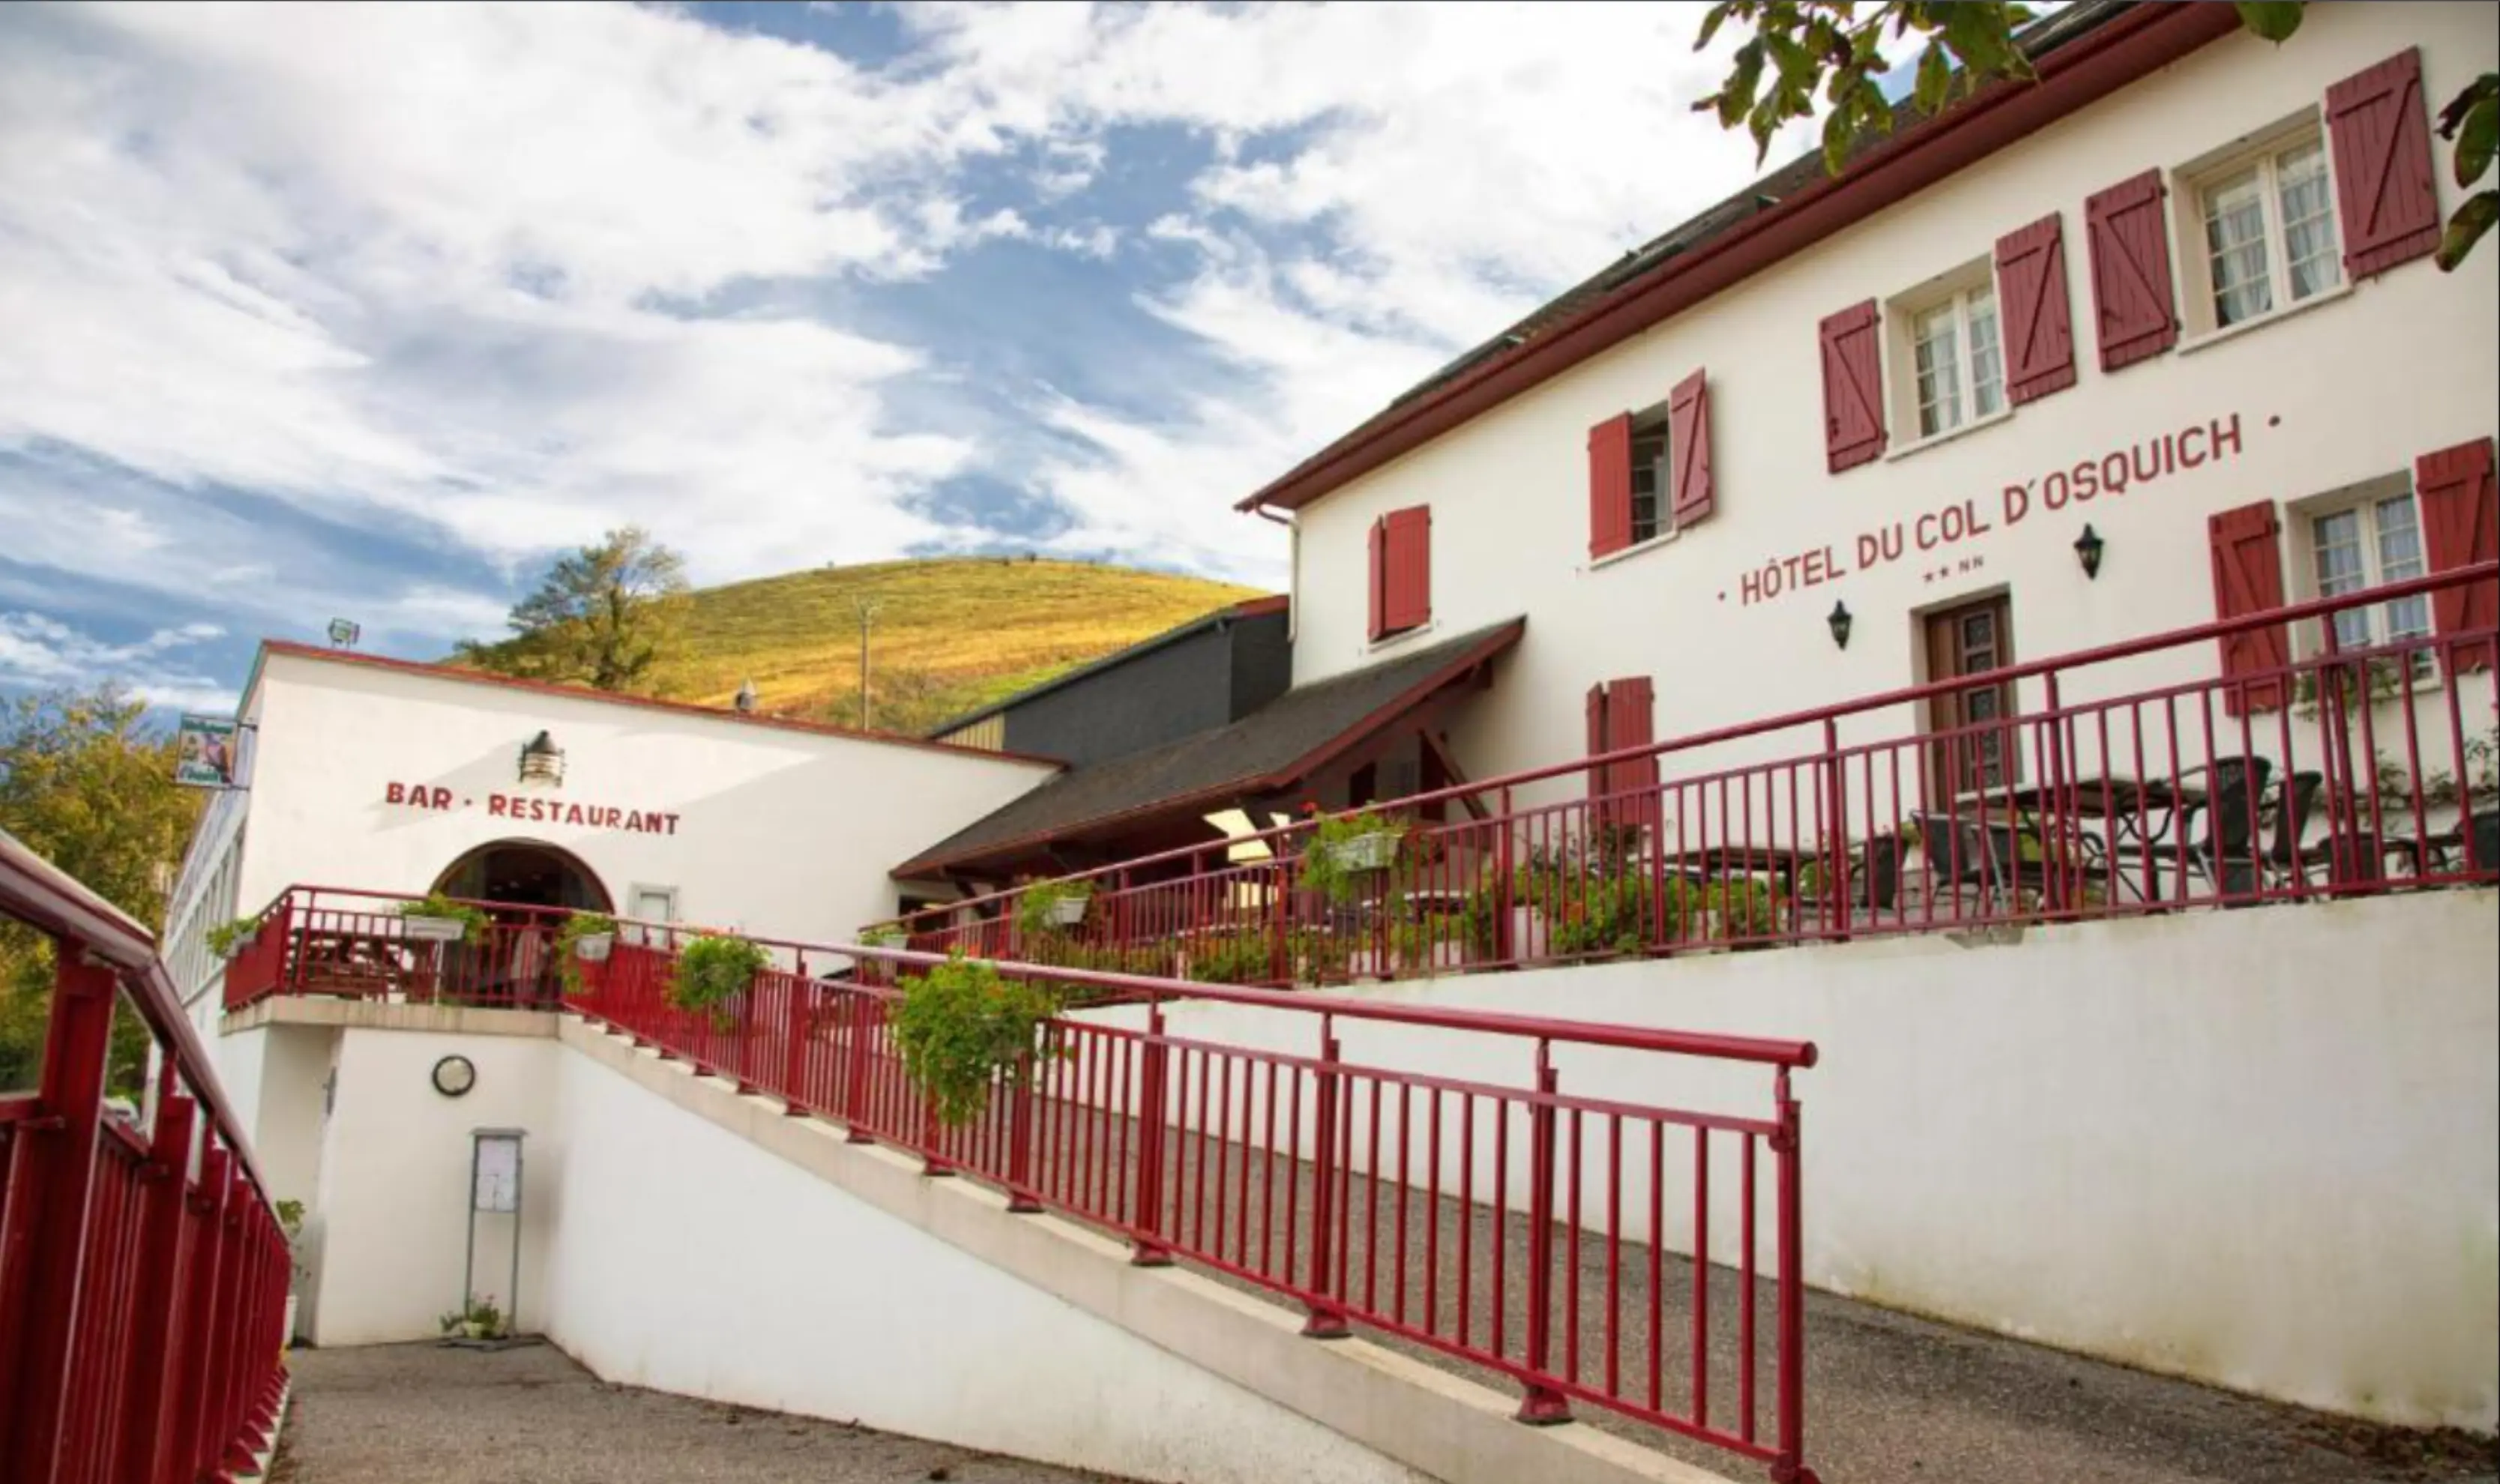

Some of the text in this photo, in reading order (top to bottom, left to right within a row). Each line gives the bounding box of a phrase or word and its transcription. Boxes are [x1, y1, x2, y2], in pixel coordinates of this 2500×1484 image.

[1741, 545, 1847, 606] HÔTEL
[1857, 522, 1904, 570] DU
[1915, 498, 1992, 552] COL
[384, 781, 681, 836] BAR RESTAURANT
